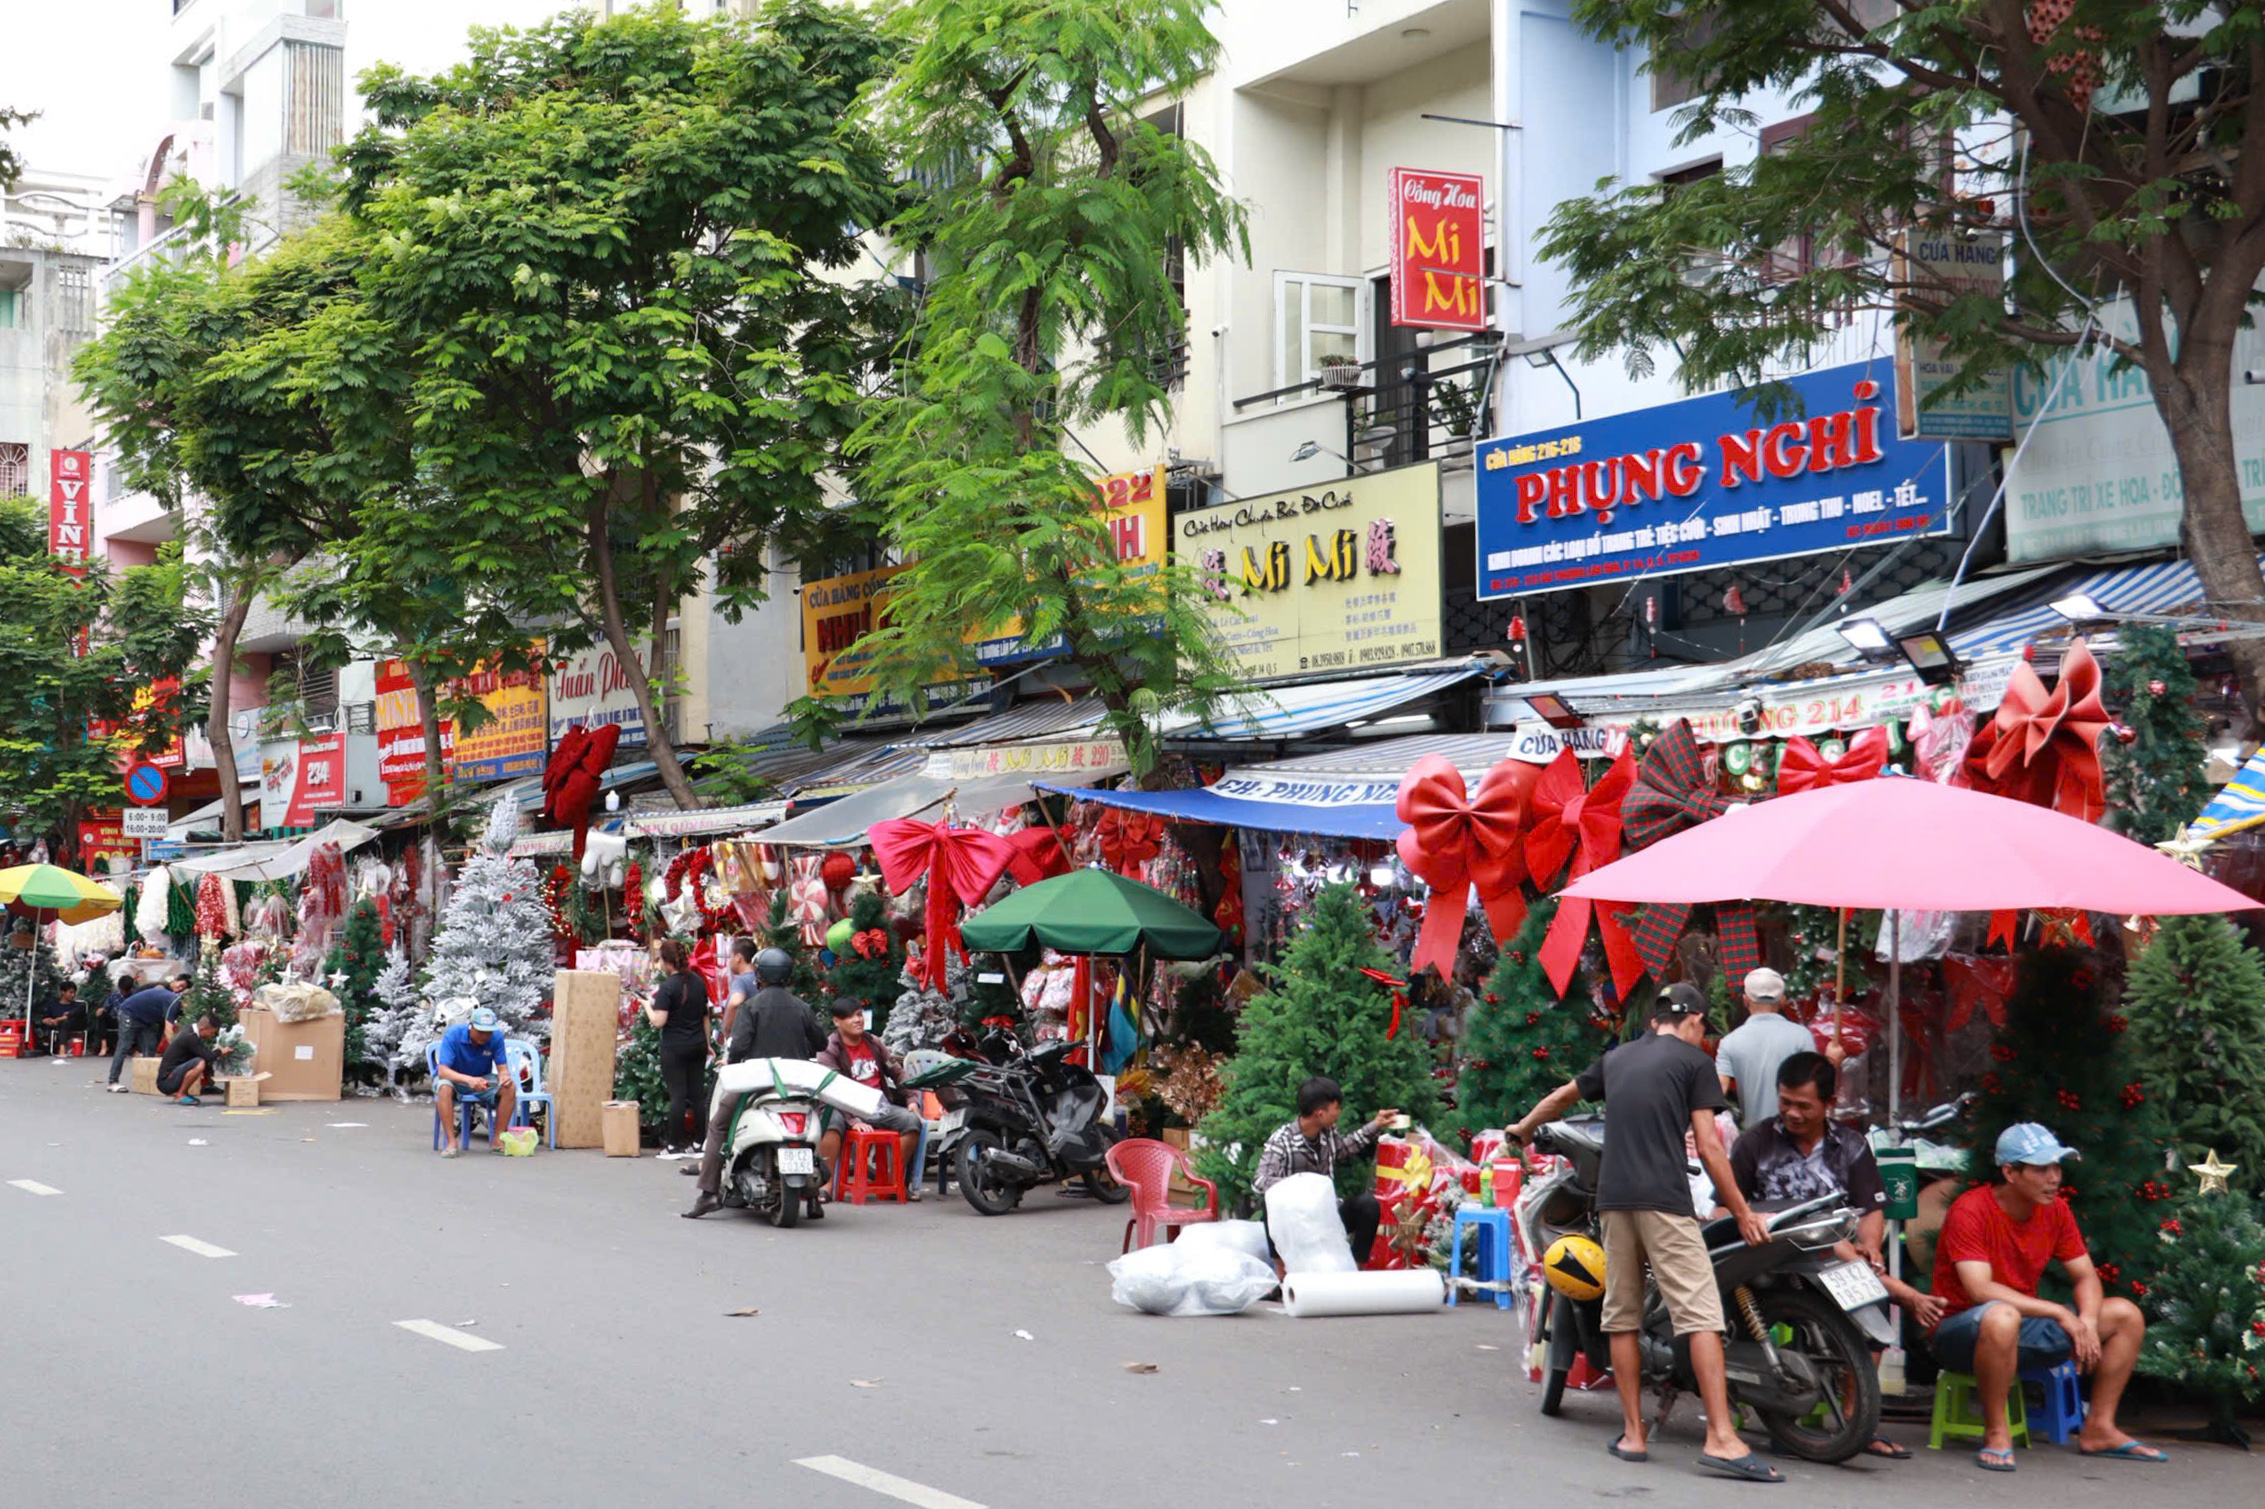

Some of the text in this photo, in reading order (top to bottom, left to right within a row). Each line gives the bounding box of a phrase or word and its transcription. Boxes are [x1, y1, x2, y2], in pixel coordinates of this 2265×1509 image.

[1404, 178, 1442, 210] Cổng
[1406, 214, 1460, 265] Mi
[1424, 270, 1478, 317] Mi
[1515, 442, 1707, 524] PHỤNG
[2020, 489, 2068, 520] TRANG
[2096, 481, 2115, 510] XE
[2119, 477, 2149, 506] HOA
[1852, 490, 1886, 514] NOEL
[1241, 528, 1358, 596] Mi Mi
[1806, 694, 1862, 725] 214
[307, 761, 330, 786] 234
[1090, 745, 1110, 766] 220
